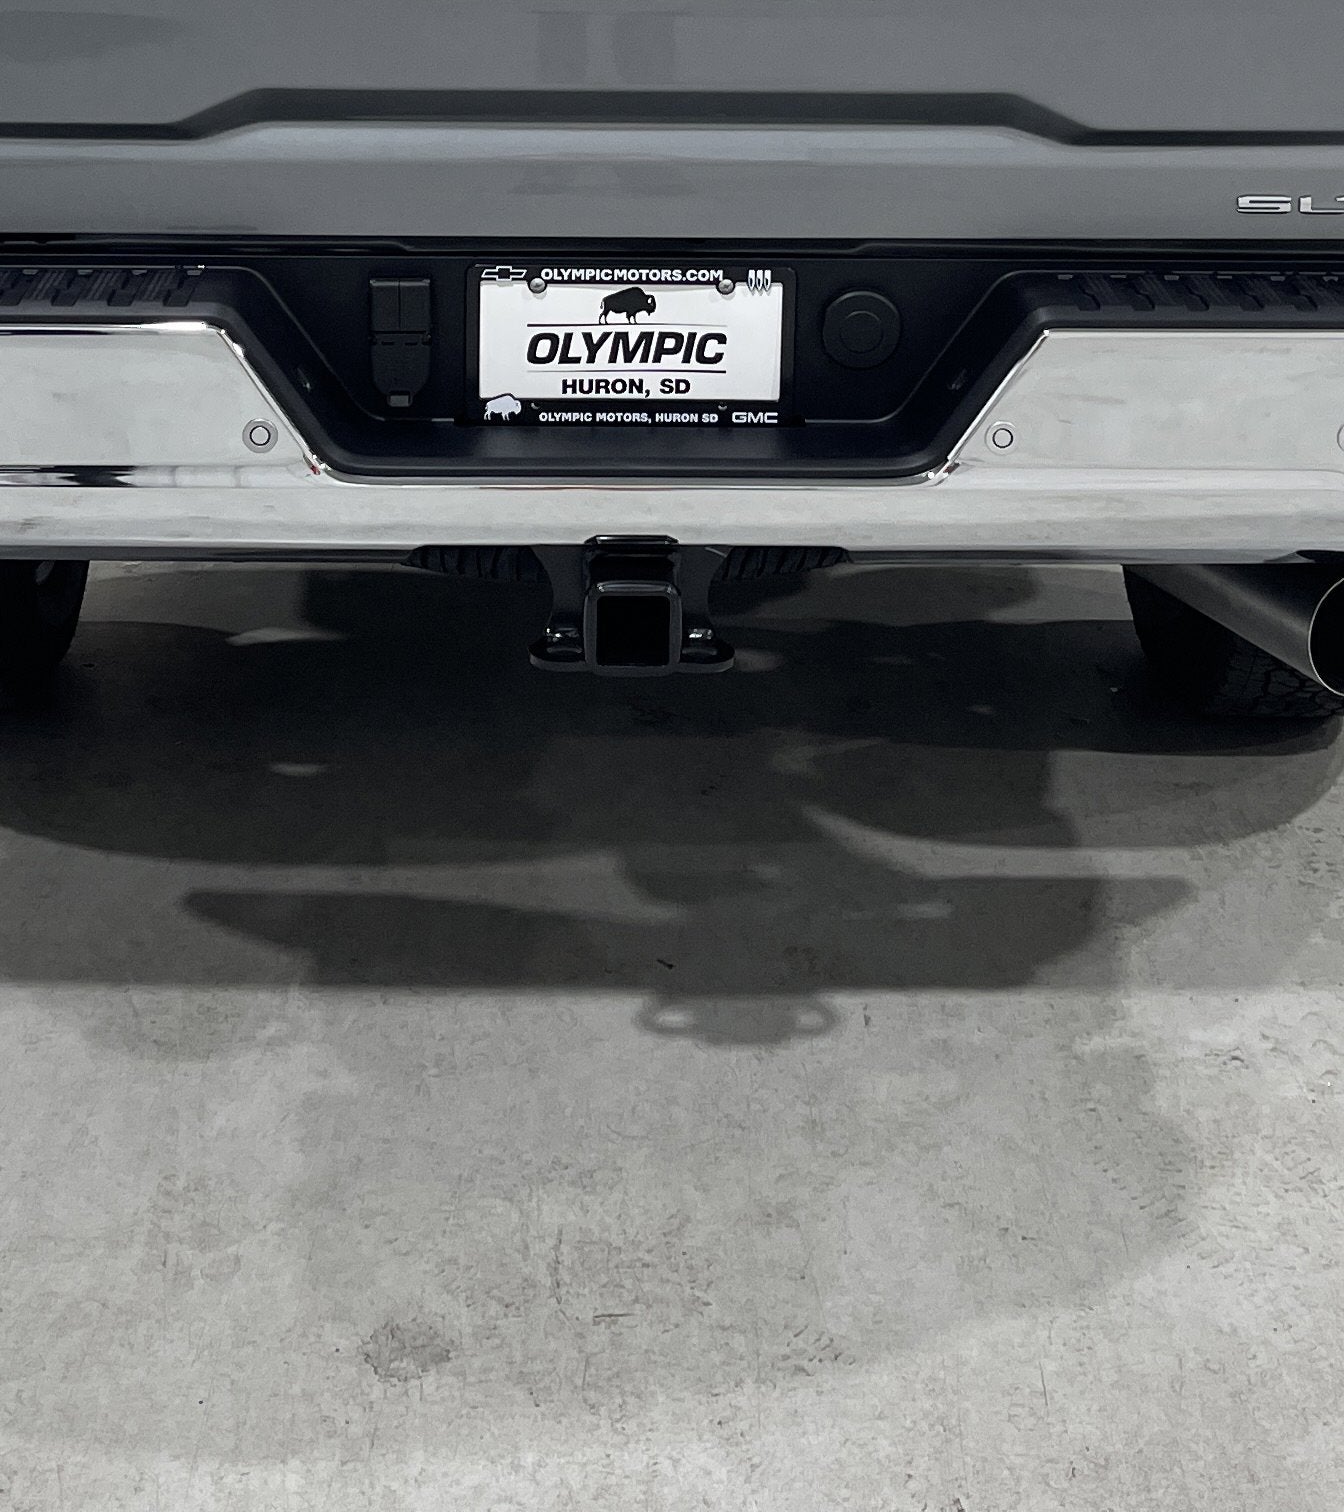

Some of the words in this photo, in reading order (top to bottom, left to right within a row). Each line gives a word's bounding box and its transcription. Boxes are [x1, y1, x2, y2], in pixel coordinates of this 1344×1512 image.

[540, 268, 723, 282] OLYMPICMOTORS.COM
[526, 331, 728, 365] OLYMPIC
[561, 378, 651, 398] HURON,
[659, 378, 691, 395] SD
[539, 411, 593, 423] OLYMPIC
[595, 411, 652, 424] MOTORS,
[656, 412, 699, 423] HURON
[702, 413, 719, 424] SD
[731, 411, 779, 424] GMC
